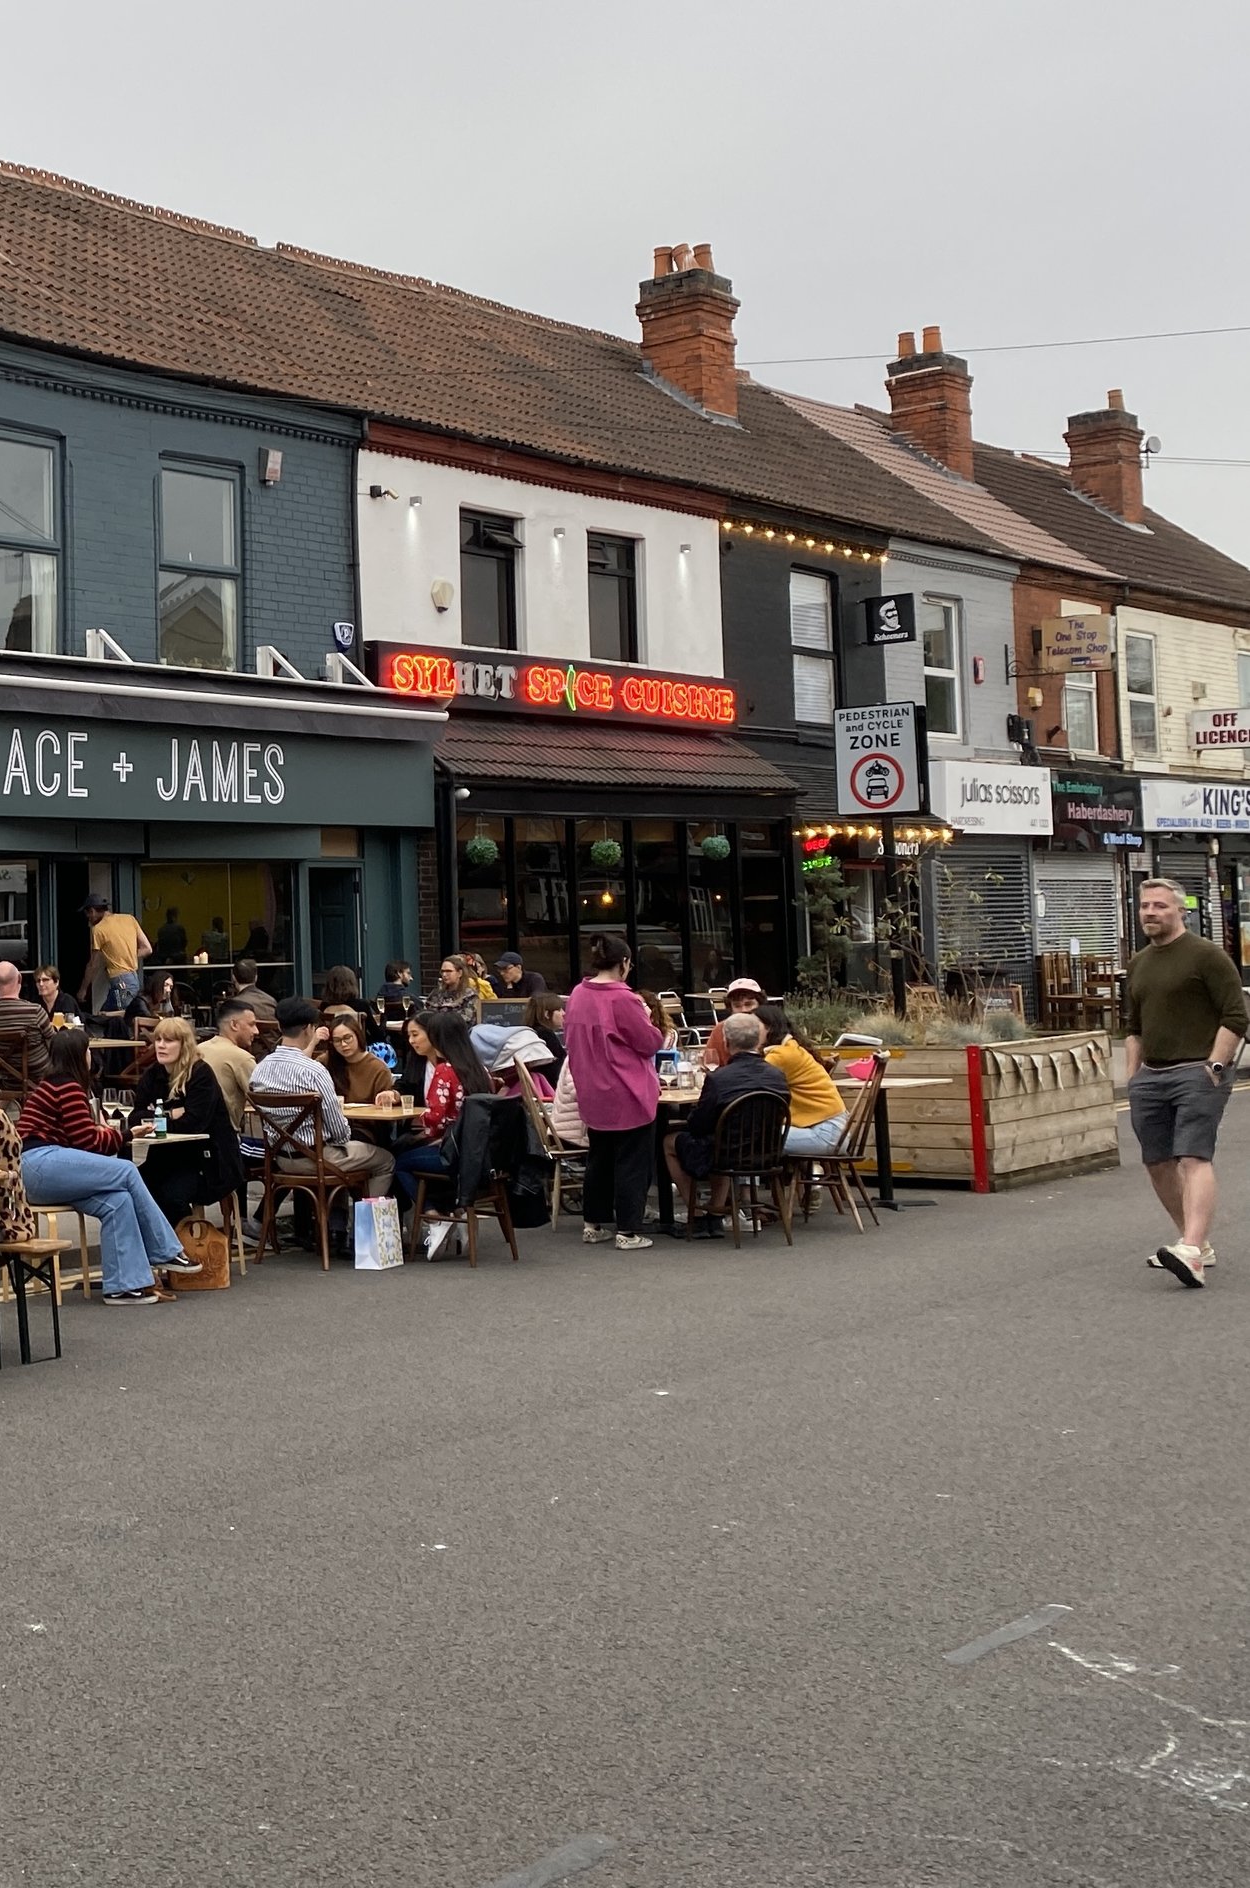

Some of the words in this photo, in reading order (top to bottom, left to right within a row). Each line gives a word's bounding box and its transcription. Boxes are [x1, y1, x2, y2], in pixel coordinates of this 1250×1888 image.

[1068, 620, 1084, 630] The
[1055, 632, 1071, 641] One
[1086, 643, 1108, 655] Shop
[392, 654, 518, 700] SYLHET
[622, 676, 735, 722] CUISINE
[838, 707, 910, 722] PEDESTRIAN
[1212, 713, 1238, 727] OFF
[845, 723, 864, 732] and
[867, 719, 904, 730] CYCLE
[850, 732, 901, 750] ZONE
[1196, 729, 1250, 745] LICENC
[156, 738, 285, 805] JAMES
[960, 776, 993, 808] julias
[995, 779, 1040, 805] scissors
[1067, 802, 1134, 826] Haberdashery
